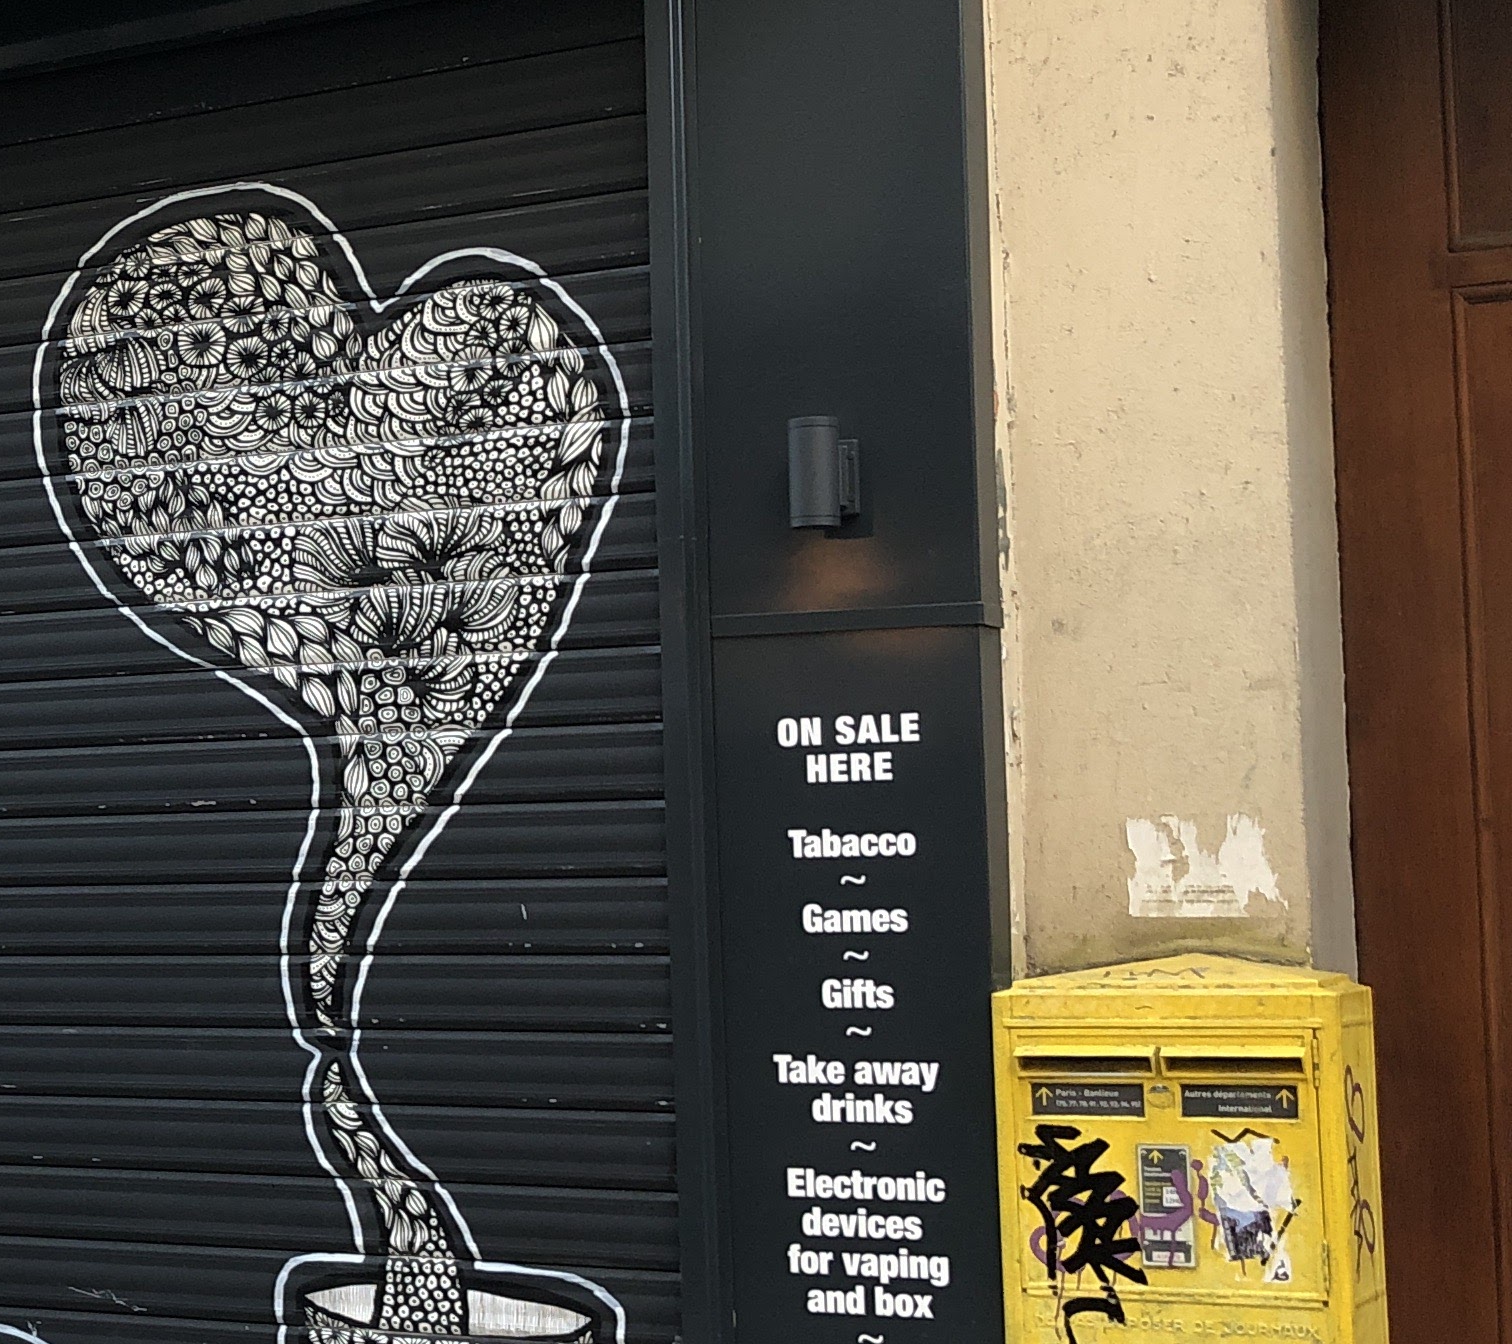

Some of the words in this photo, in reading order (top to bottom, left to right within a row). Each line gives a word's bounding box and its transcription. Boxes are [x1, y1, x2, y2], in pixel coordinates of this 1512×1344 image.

[776, 716, 823, 748] ON
[834, 712, 921, 746] SALE
[805, 751, 894, 784] HERE
[787, 828, 917, 858] Tabacco
[802, 903, 909, 933] Games
[821, 978, 895, 1009] Gifts
[772, 1054, 846, 1085] Take
[853, 1061, 940, 1093] away
[811, 1092, 914, 1125] drinks
[1184, 1089, 1212, 1098] Autres
[786, 1167, 947, 1203] Electronic
[802, 1206, 924, 1241] devices
[787, 1243, 834, 1276] for
[841, 1248, 951, 1287] vaping
[807, 1285, 866, 1316] and
[874, 1285, 935, 1320] box
